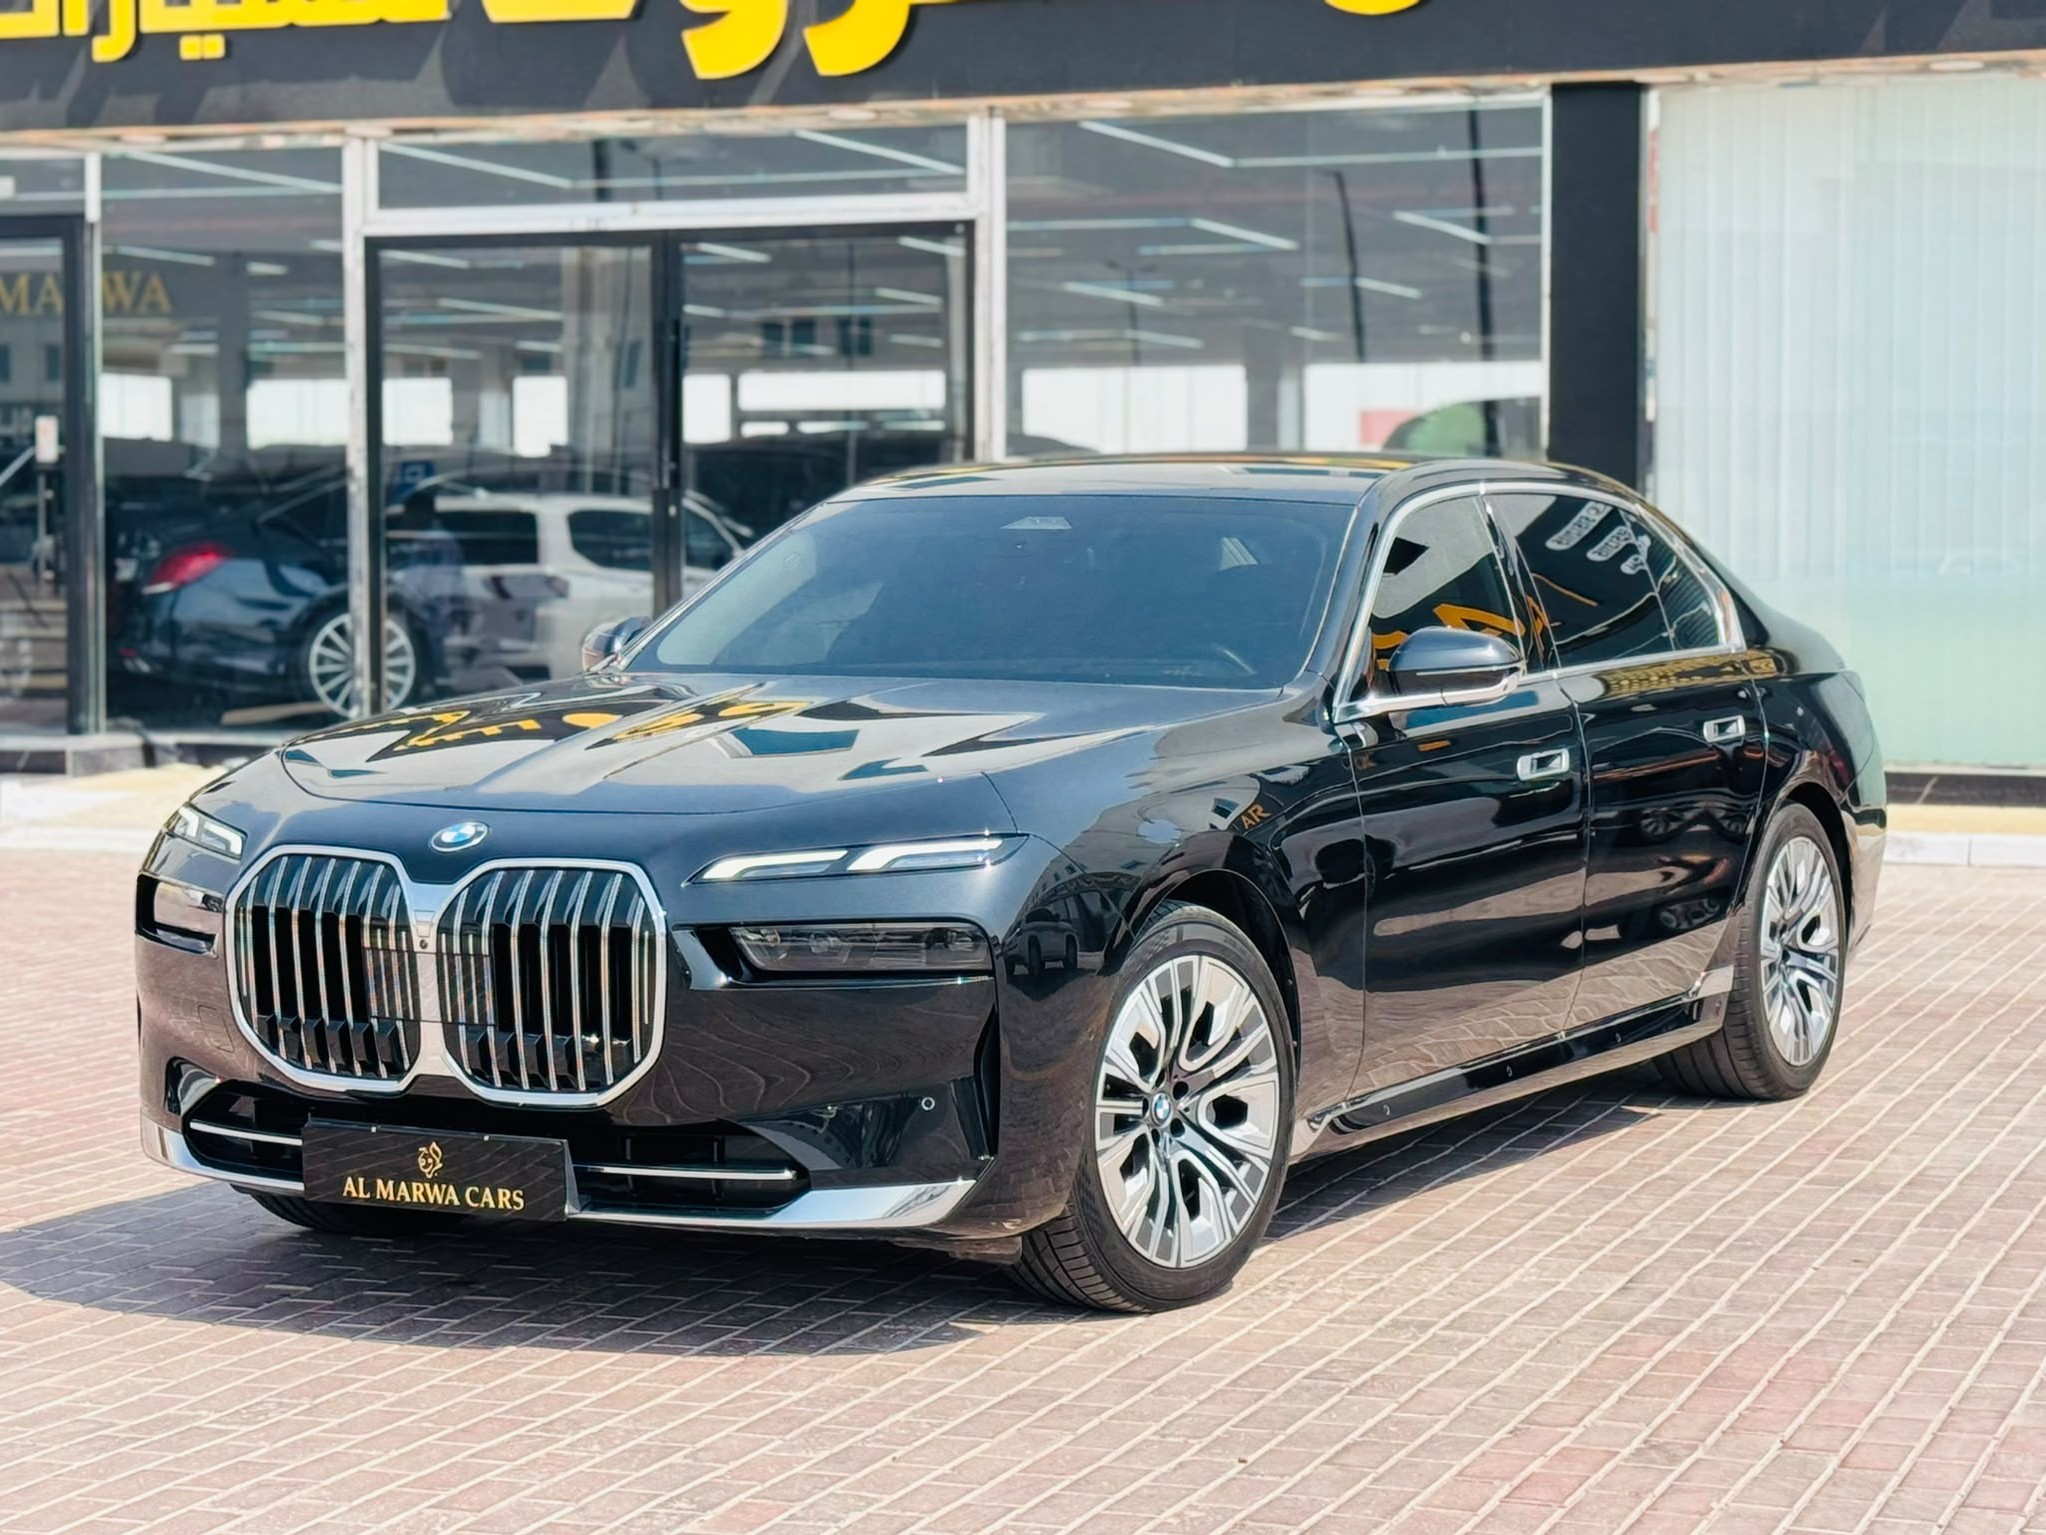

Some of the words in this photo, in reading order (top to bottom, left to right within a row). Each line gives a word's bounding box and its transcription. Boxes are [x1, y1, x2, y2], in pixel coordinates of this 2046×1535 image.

[0, 271, 173, 315] MAWA
[342, 1176, 370, 1199] AL
[376, 1178, 461, 1206] MARWA
[465, 1186, 525, 1211] CARS
